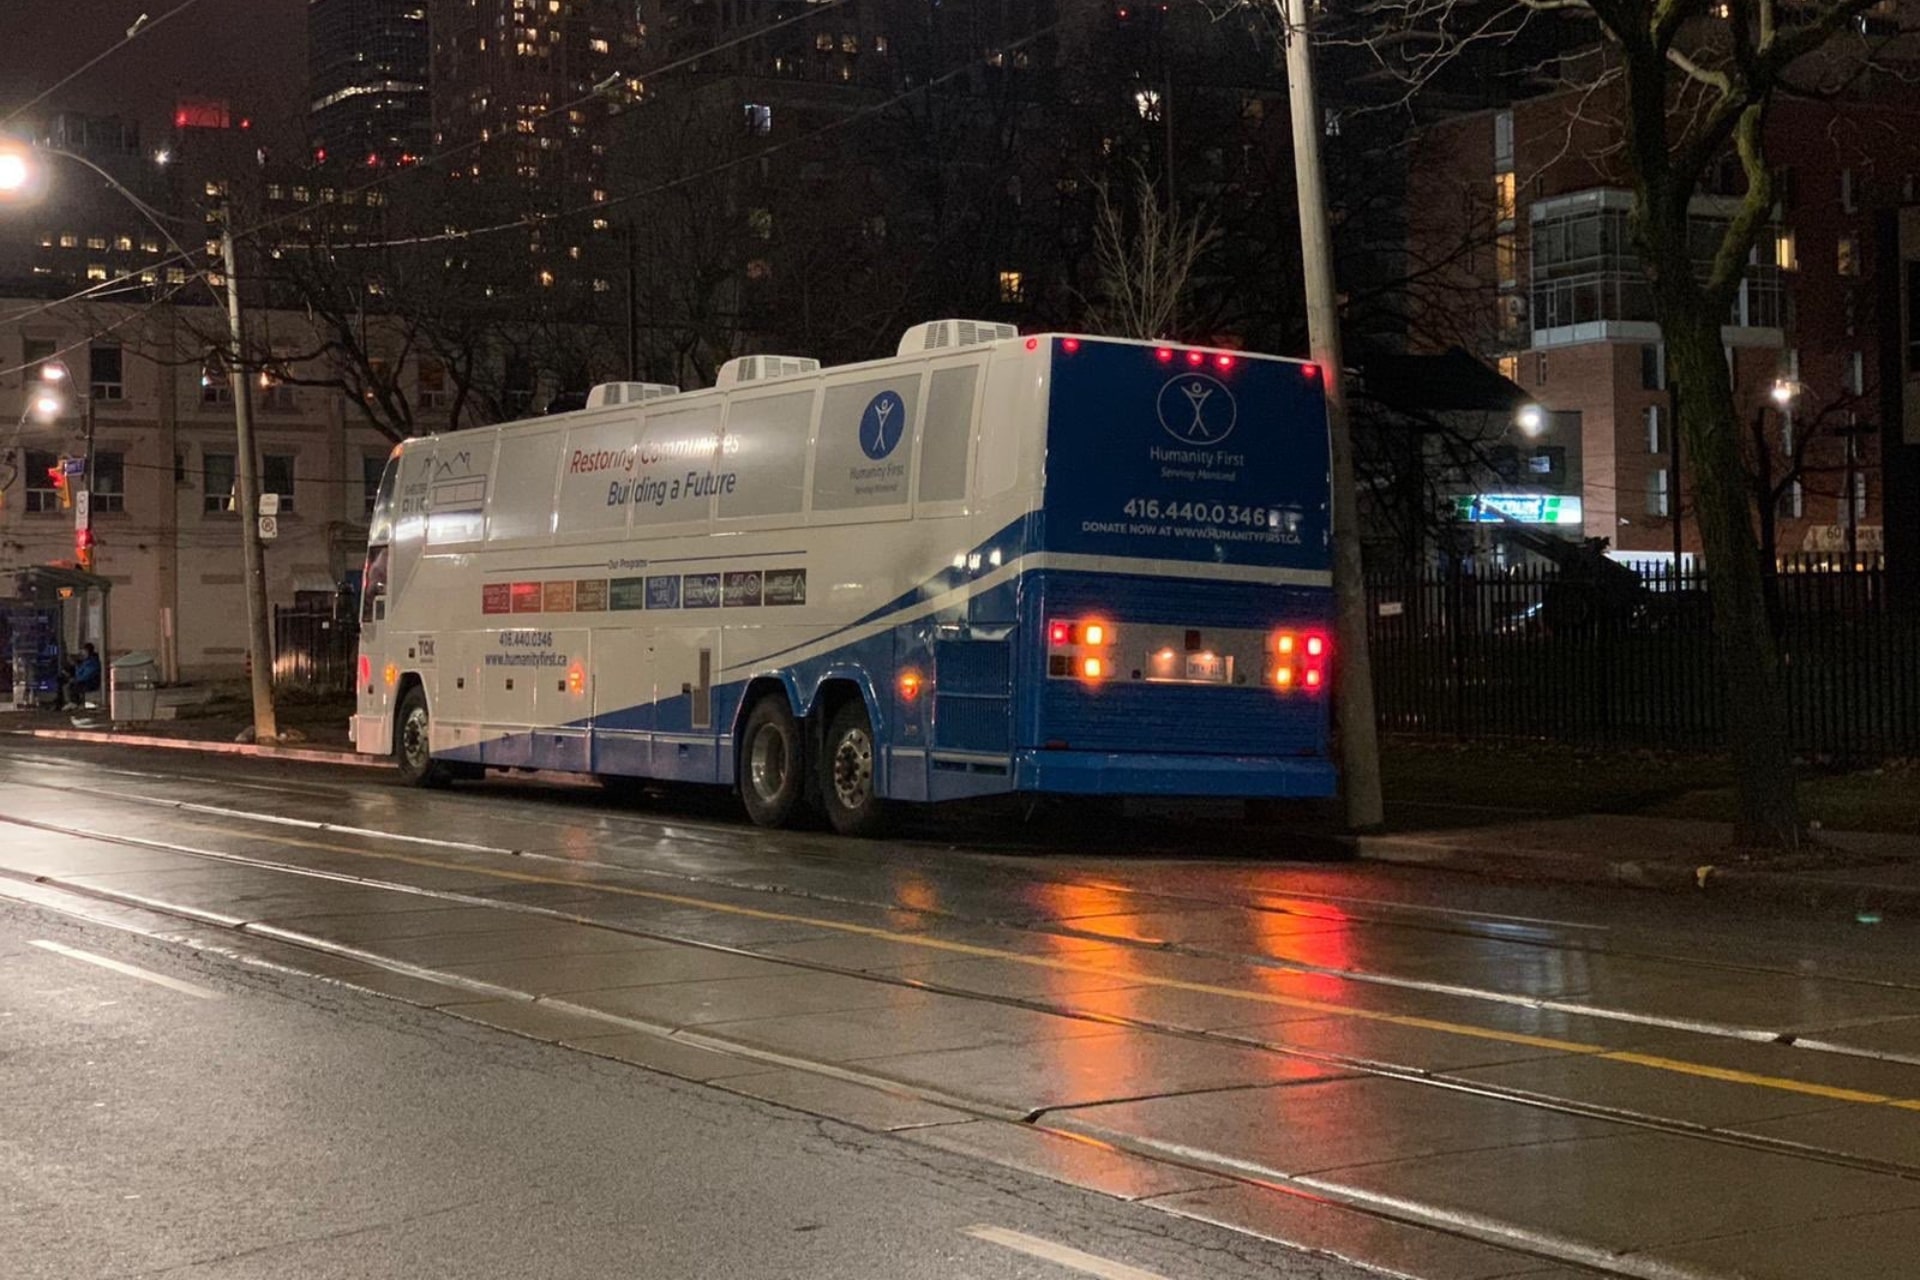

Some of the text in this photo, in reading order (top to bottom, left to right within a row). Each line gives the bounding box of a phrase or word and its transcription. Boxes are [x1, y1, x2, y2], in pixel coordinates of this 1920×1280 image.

[570, 445, 637, 474] Restoring
[1150, 446, 1244, 468] Humanity First
[607, 471, 736, 506] Building a Future
[1123, 499, 1265, 526] 416.440.0346
[1082, 521, 1127, 533] DONATE
[1129, 525, 1157, 536] NOW
[1159, 526, 1172, 536] AT
[499, 632, 552, 648] 416.440.0346
[485, 651, 567, 669] www.humanityfirst.ca
